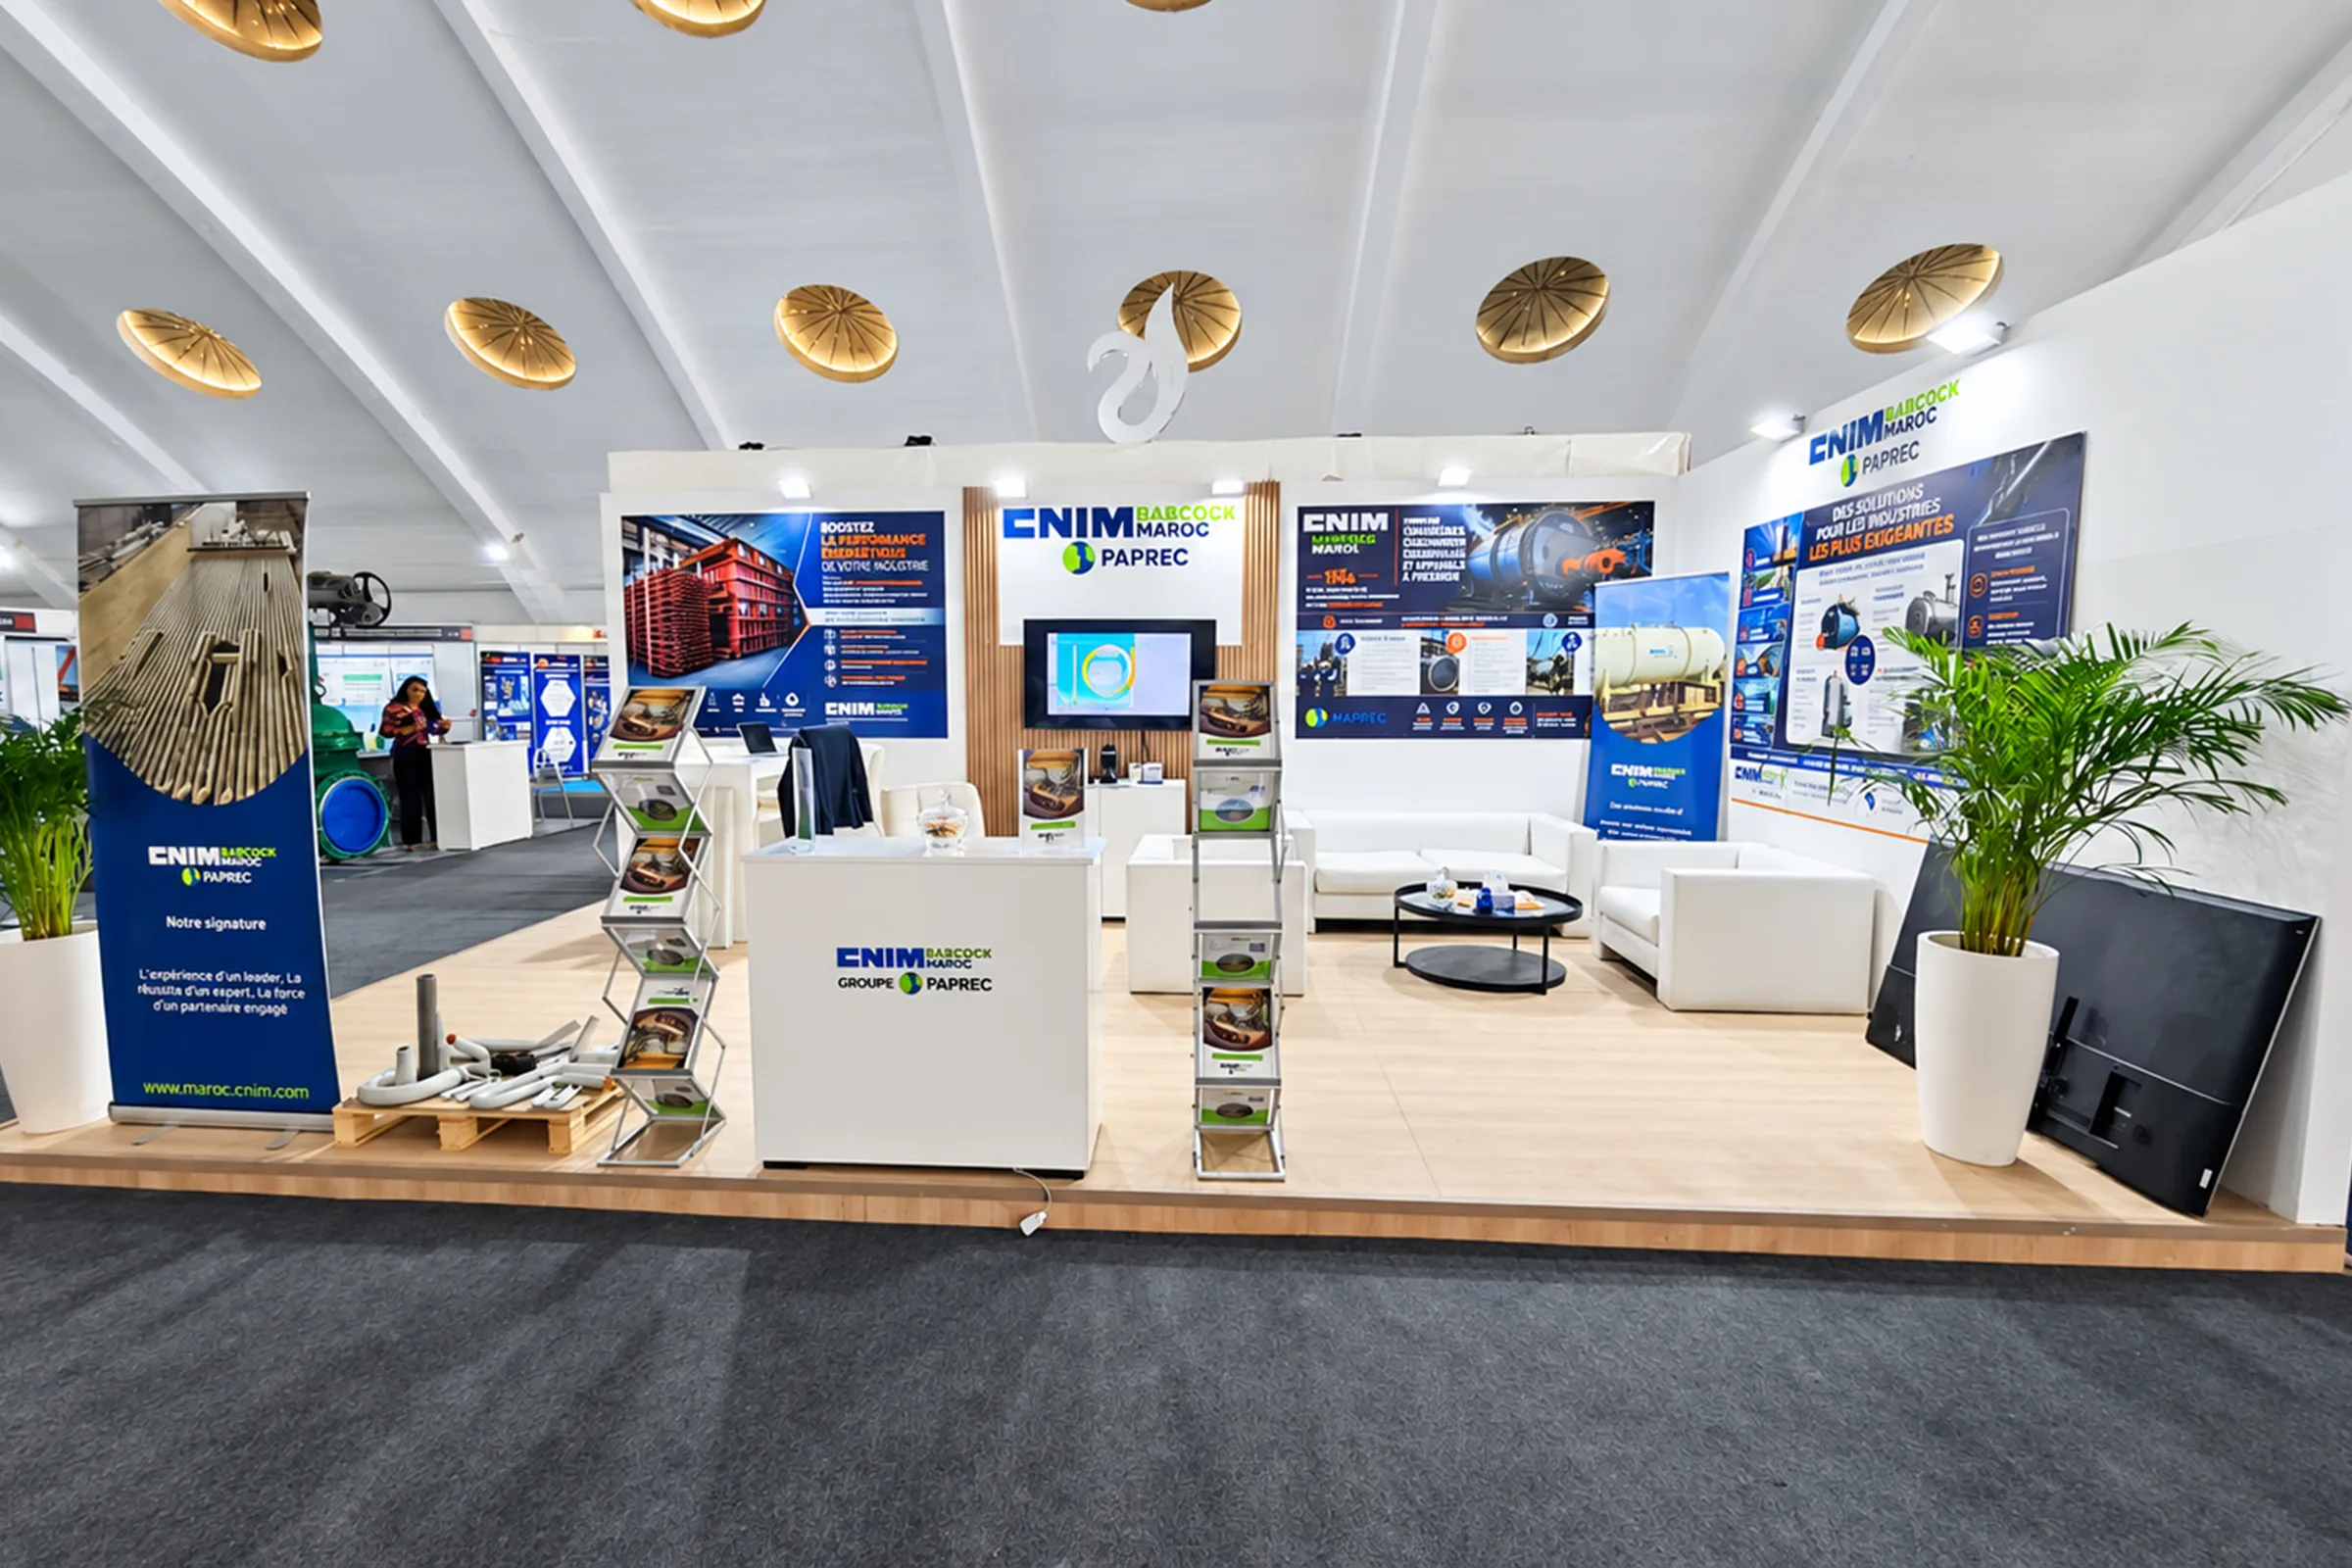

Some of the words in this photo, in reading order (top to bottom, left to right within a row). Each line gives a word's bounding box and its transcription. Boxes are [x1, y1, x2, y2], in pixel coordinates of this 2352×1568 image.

[1884, 407, 1937, 439] MAROC
[1809, 409, 1884, 466] CNIM
[1862, 441, 1920, 474] PAPREC
[1003, 507, 1134, 538] CNIM
[1137, 506, 1236, 520] BABCOCK
[1137, 522, 1209, 537] MAROC
[1302, 513, 1389, 532] CNIM
[1864, 514, 1955, 550] EXIGEANTES
[1102, 548, 1189, 566] PAPREC
[824, 703, 875, 715] CNIM
[148, 846, 220, 865] CNIM
[203, 870, 252, 883] PAPREC
[166, 915, 202, 929] Notre
[204, 916, 267, 932] signature
[836, 947, 924, 968] CNIM
[215, 970, 241, 982] d'un
[837, 977, 894, 989] GROUPE
[926, 977, 993, 992] PAPREC
[153, 999, 178, 1011] d'un
[180, 1001, 241, 1014] partenaire
[143, 1082, 310, 1100] www.maroc.cnim.com
